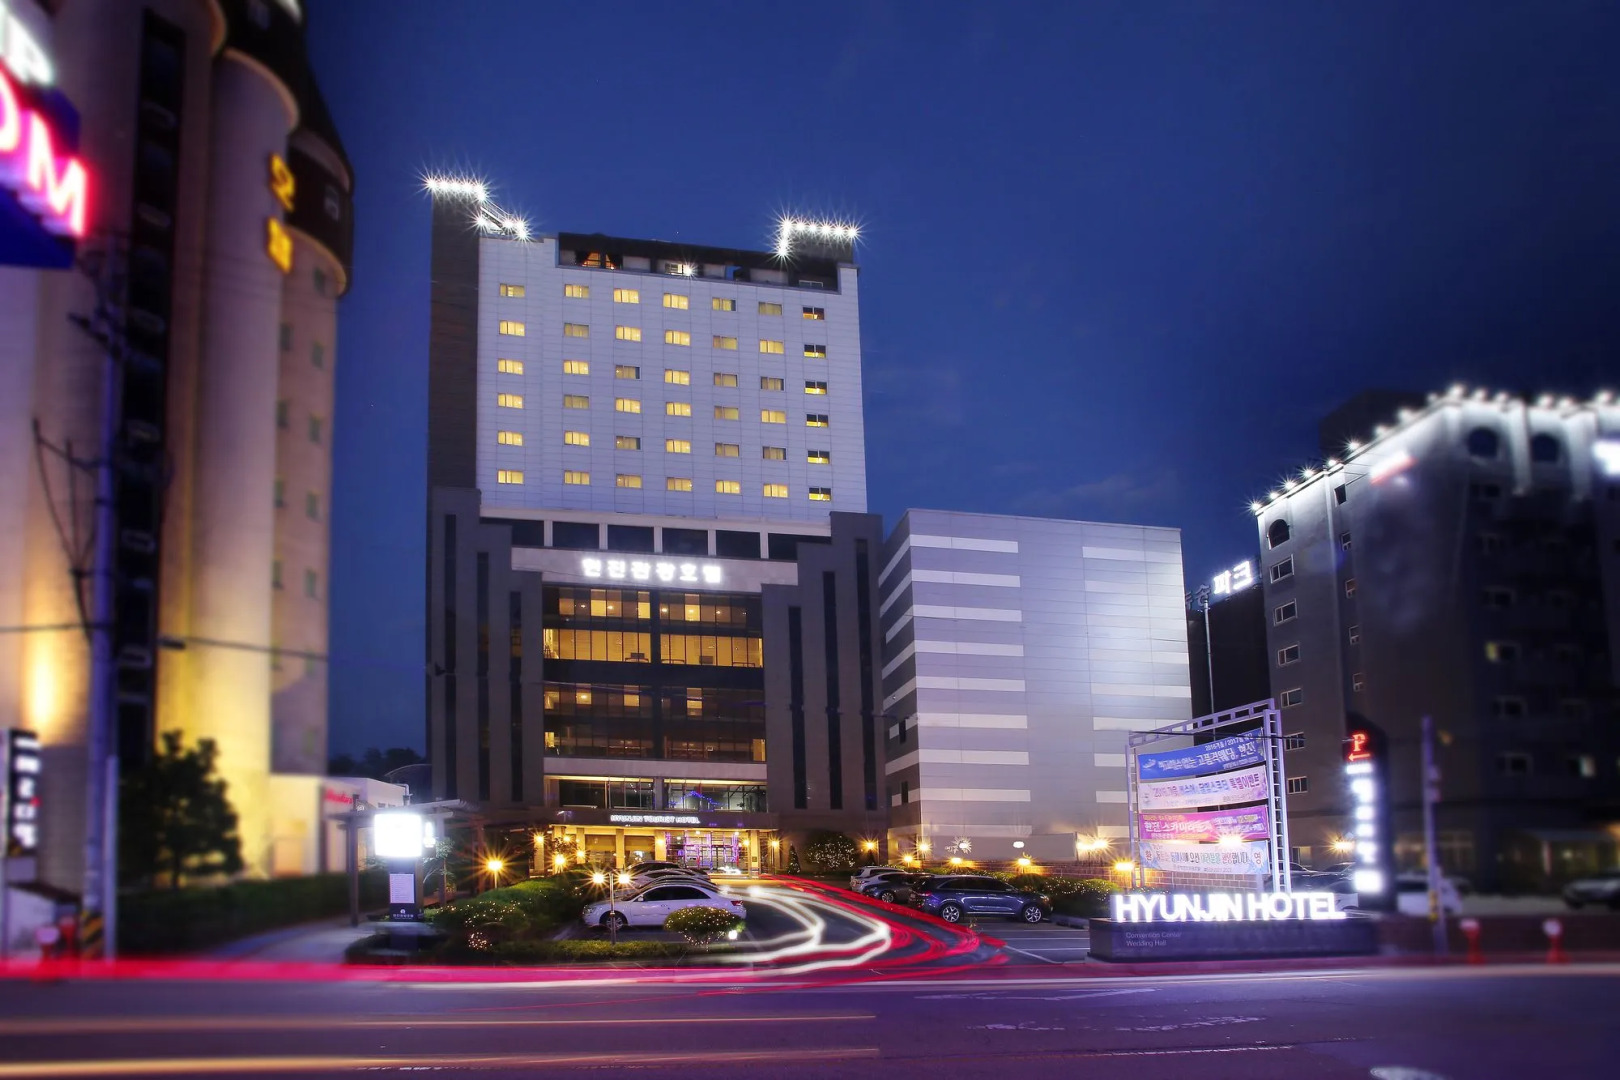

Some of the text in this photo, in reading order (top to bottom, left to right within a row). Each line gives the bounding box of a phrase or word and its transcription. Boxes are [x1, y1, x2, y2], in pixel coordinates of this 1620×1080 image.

[1351, 733, 1367, 752] P
[1115, 891, 1347, 922] HYUNJIN HOTEL
